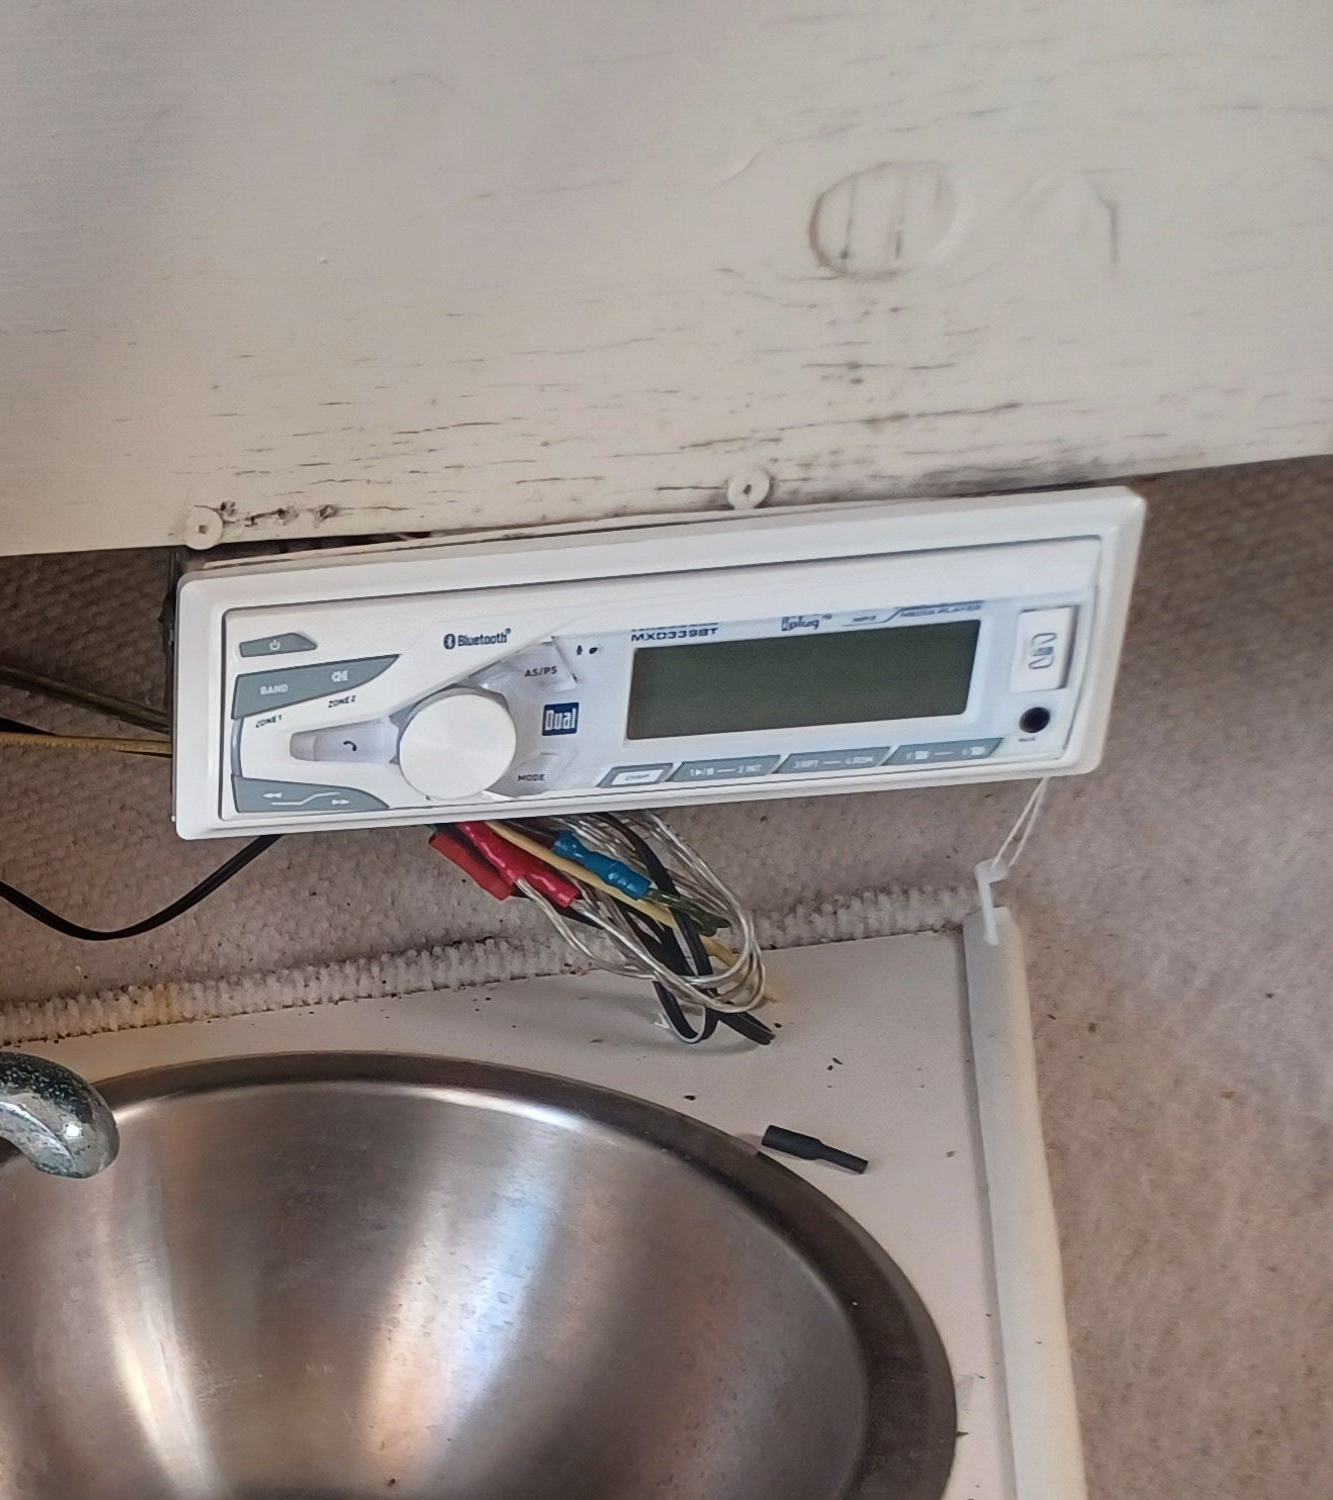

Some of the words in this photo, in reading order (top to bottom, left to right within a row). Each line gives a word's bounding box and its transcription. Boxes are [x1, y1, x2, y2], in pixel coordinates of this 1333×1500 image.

[524, 665, 558, 678] AS/PS
[545, 707, 577, 732] Dual
[518, 773, 544, 783] MODE
